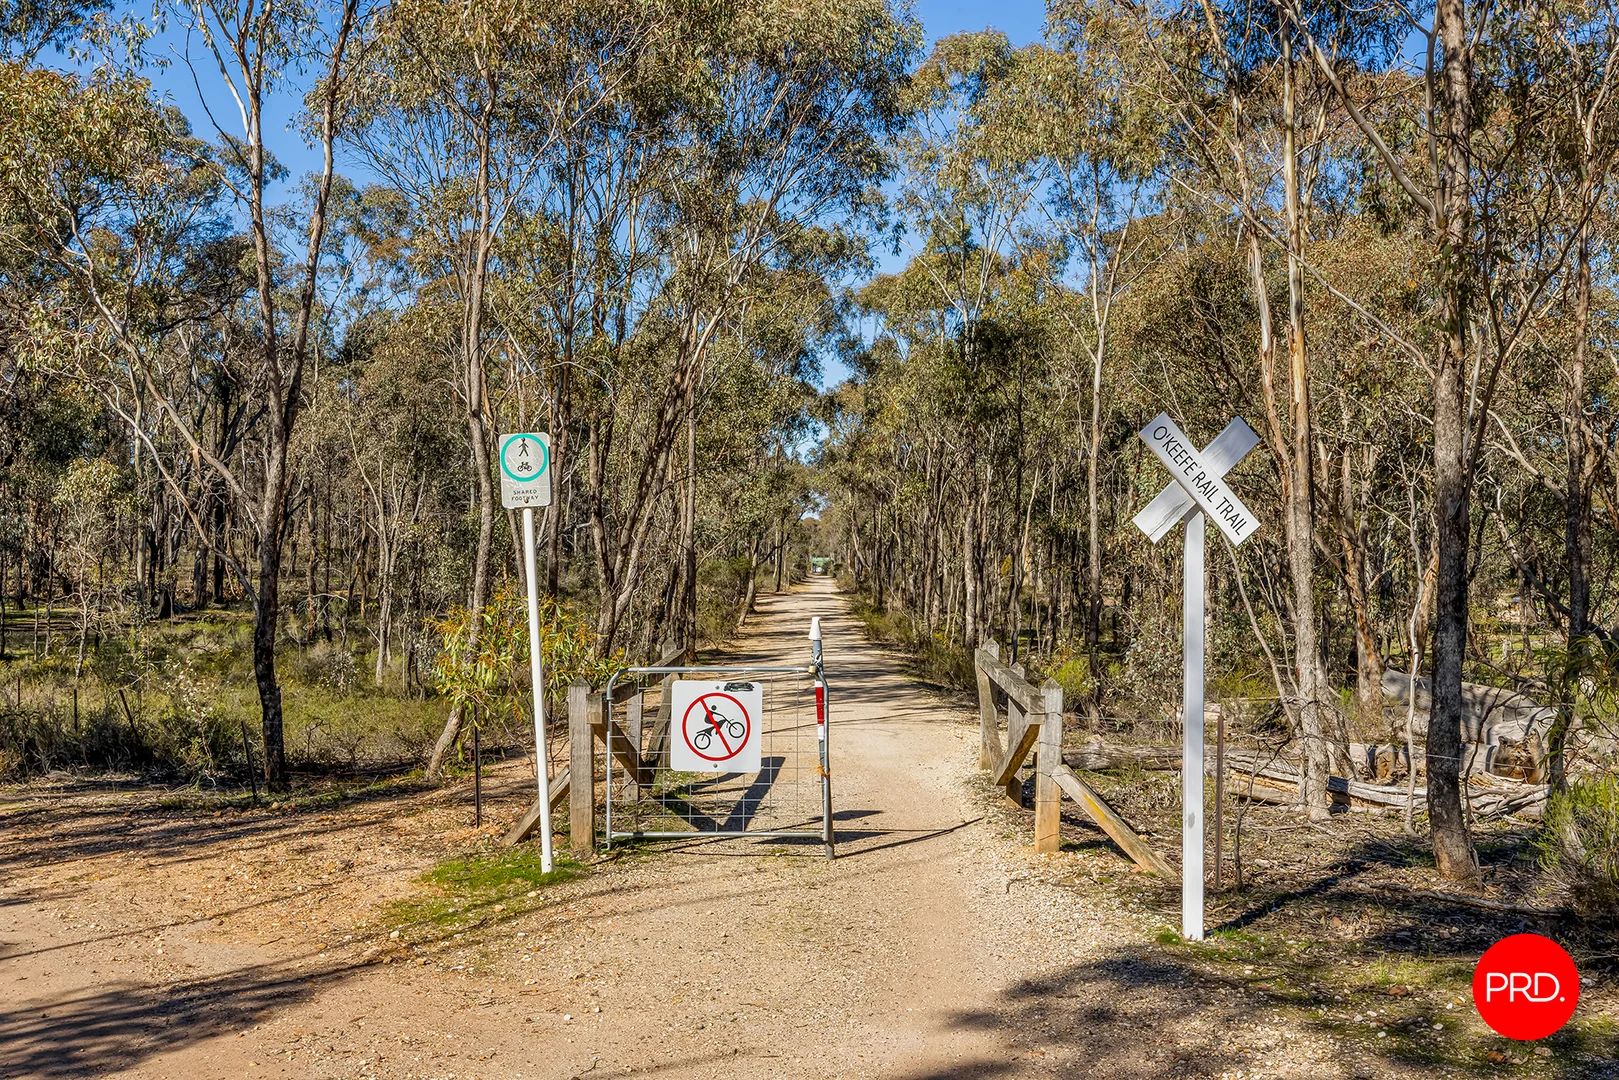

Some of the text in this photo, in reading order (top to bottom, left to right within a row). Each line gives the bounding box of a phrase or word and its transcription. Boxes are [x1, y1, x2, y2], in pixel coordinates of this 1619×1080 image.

[1153, 426, 1247, 536] O'KEEFE RAIL TRAIL
